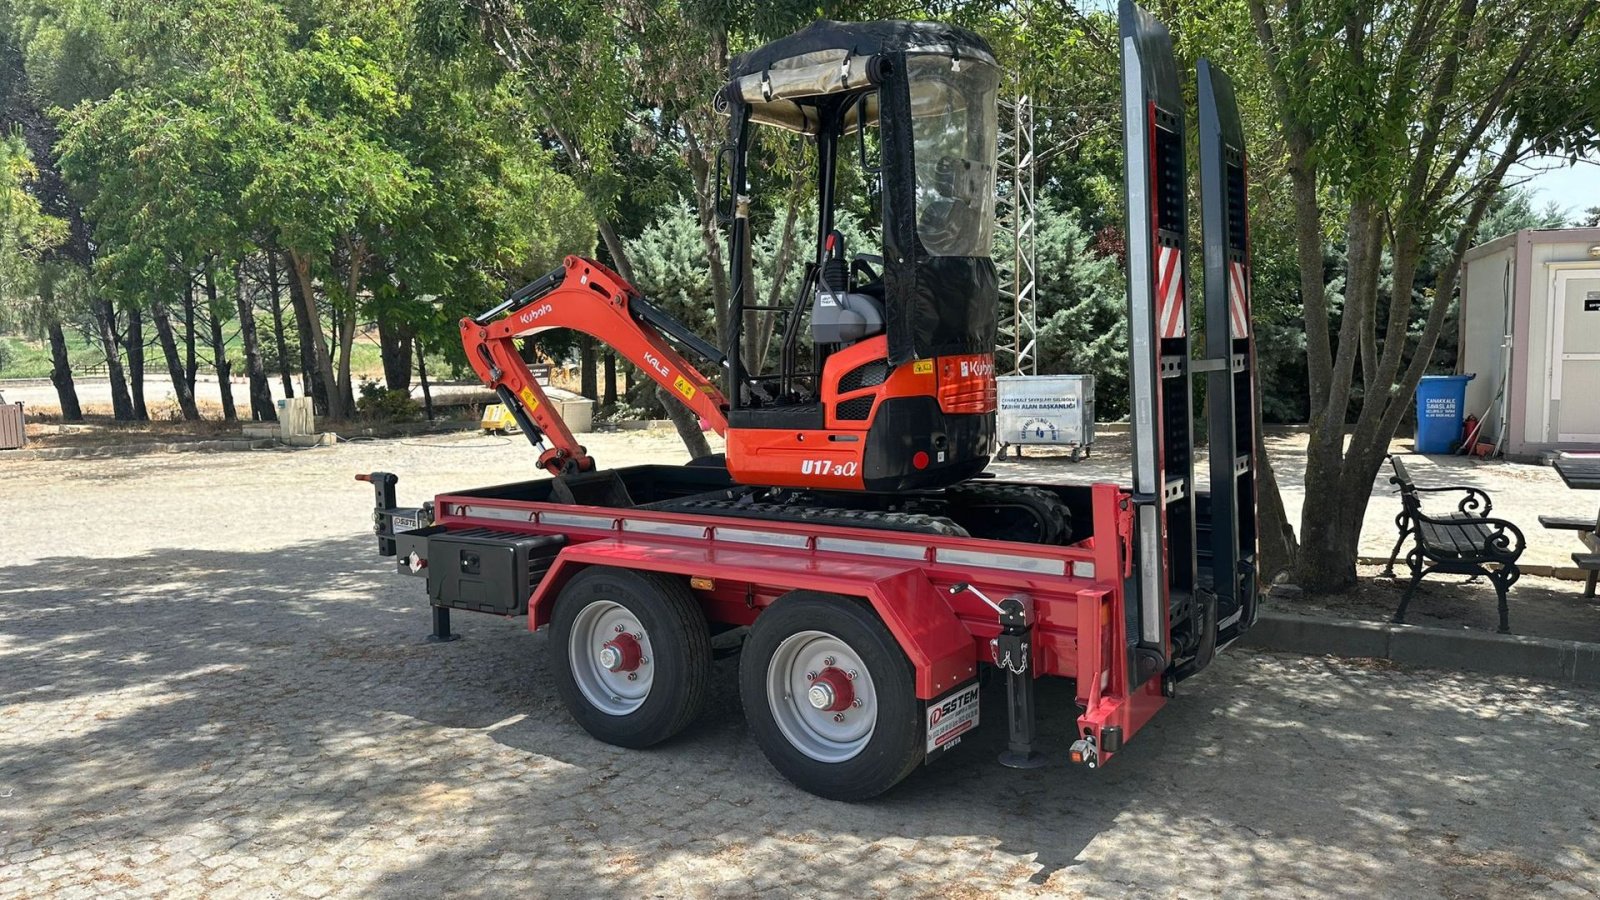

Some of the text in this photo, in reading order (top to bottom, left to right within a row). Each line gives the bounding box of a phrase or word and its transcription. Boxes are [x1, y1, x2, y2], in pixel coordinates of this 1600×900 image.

[520, 304, 552, 323] Kubota
[643, 351, 670, 378] KALE
[943, 735, 961, 751] KONYA
